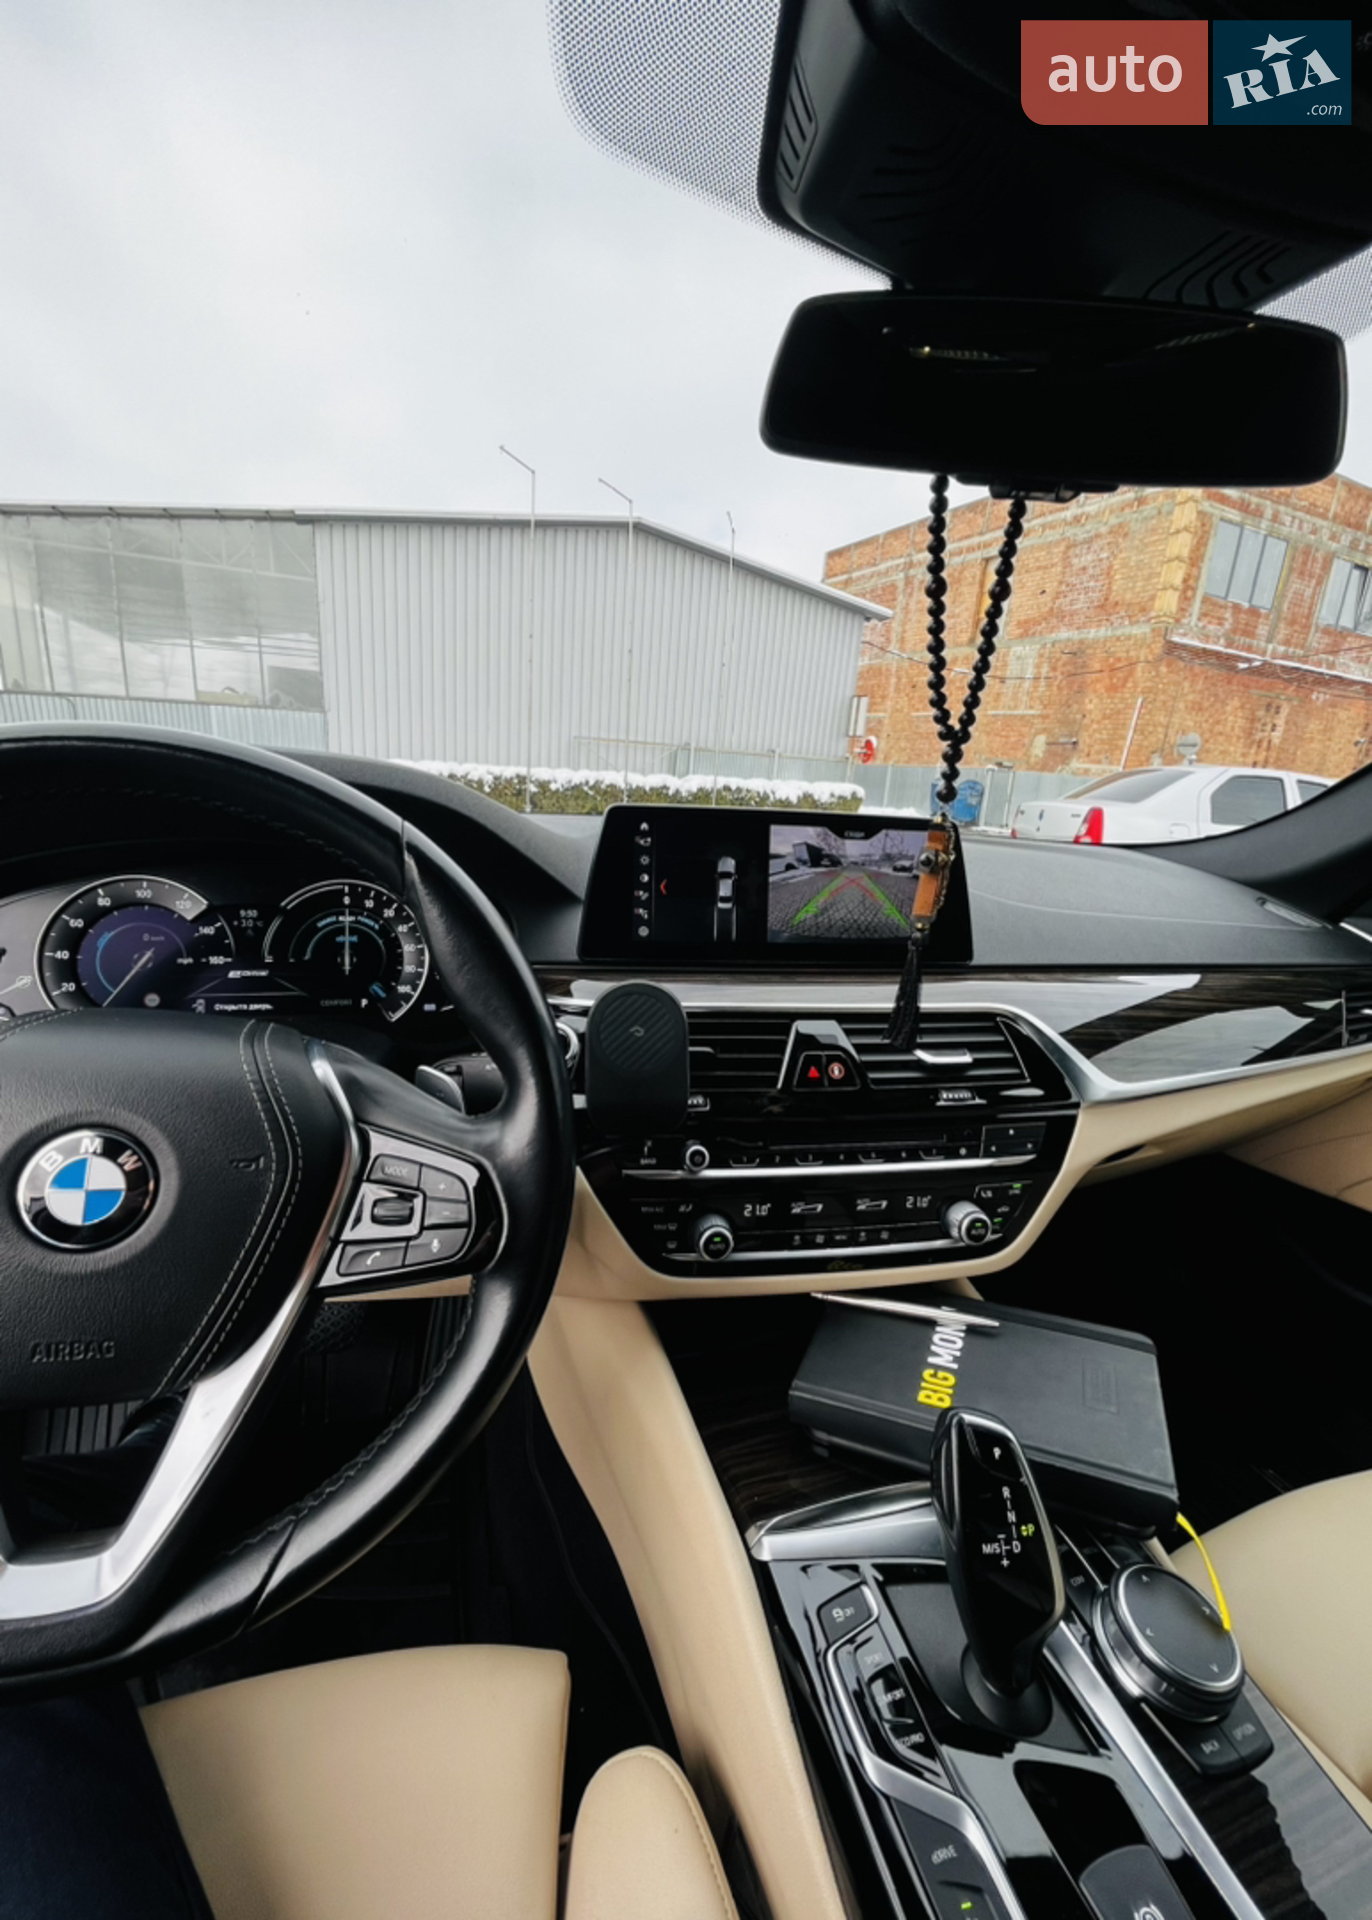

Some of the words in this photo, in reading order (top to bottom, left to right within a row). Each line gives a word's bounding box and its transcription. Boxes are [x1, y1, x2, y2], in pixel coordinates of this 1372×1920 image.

[135, 889, 152, 899] 100
[97, 897, 111, 907] 80
[175, 900, 191, 909] 120
[343, 896, 351, 905] 0
[364, 900, 374, 908] 10
[383, 909, 395, 918] 20
[69, 918, 84, 928] 60
[398, 924, 408, 933] 40
[404, 943, 416, 952] 60
[54, 950, 69, 960] 40
[405, 965, 416, 974] 80
[61, 983, 76, 992] 20
[397, 984, 412, 994] 100
[361, 999, 369, 1009] P
[39, 1137, 143, 1173] BMW
[385, 1166, 408, 1176] MODE
[31, 1341, 115, 1363] AIRBAG
[917, 1368, 956, 1409] BIG
[993, 1447, 1001, 1460] P
[1002, 1486, 1011, 1499] R
[1007, 1510, 1017, 1523] N
[1027, 1524, 1035, 1536] P
[982, 1543, 1000, 1554] M/S
[1013, 1541, 1021, 1553] D
